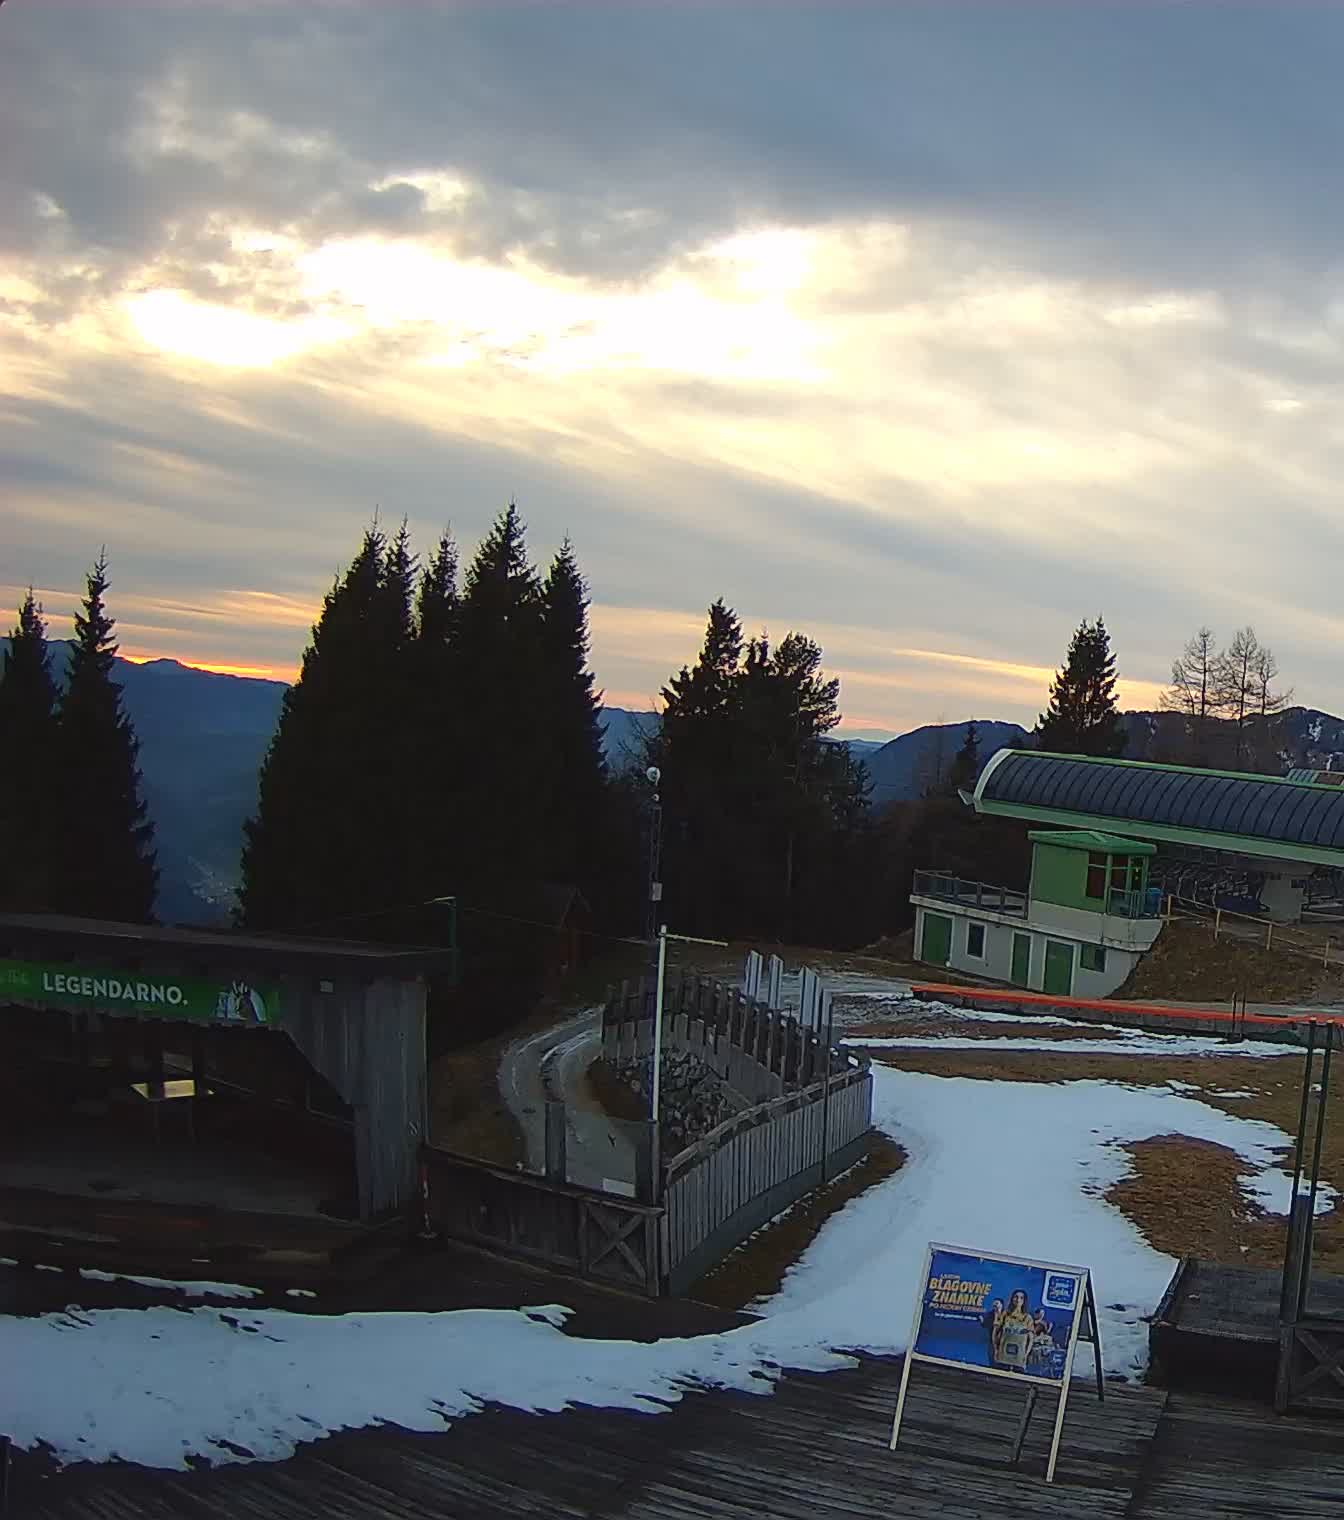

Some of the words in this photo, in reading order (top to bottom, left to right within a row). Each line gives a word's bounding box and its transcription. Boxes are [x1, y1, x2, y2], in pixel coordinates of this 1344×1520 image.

[42, 972, 188, 1006] LEGENDARNO.
[929, 1277, 992, 1295] BLAGOVNE
[932, 1290, 985, 1306] ZNAMKE
